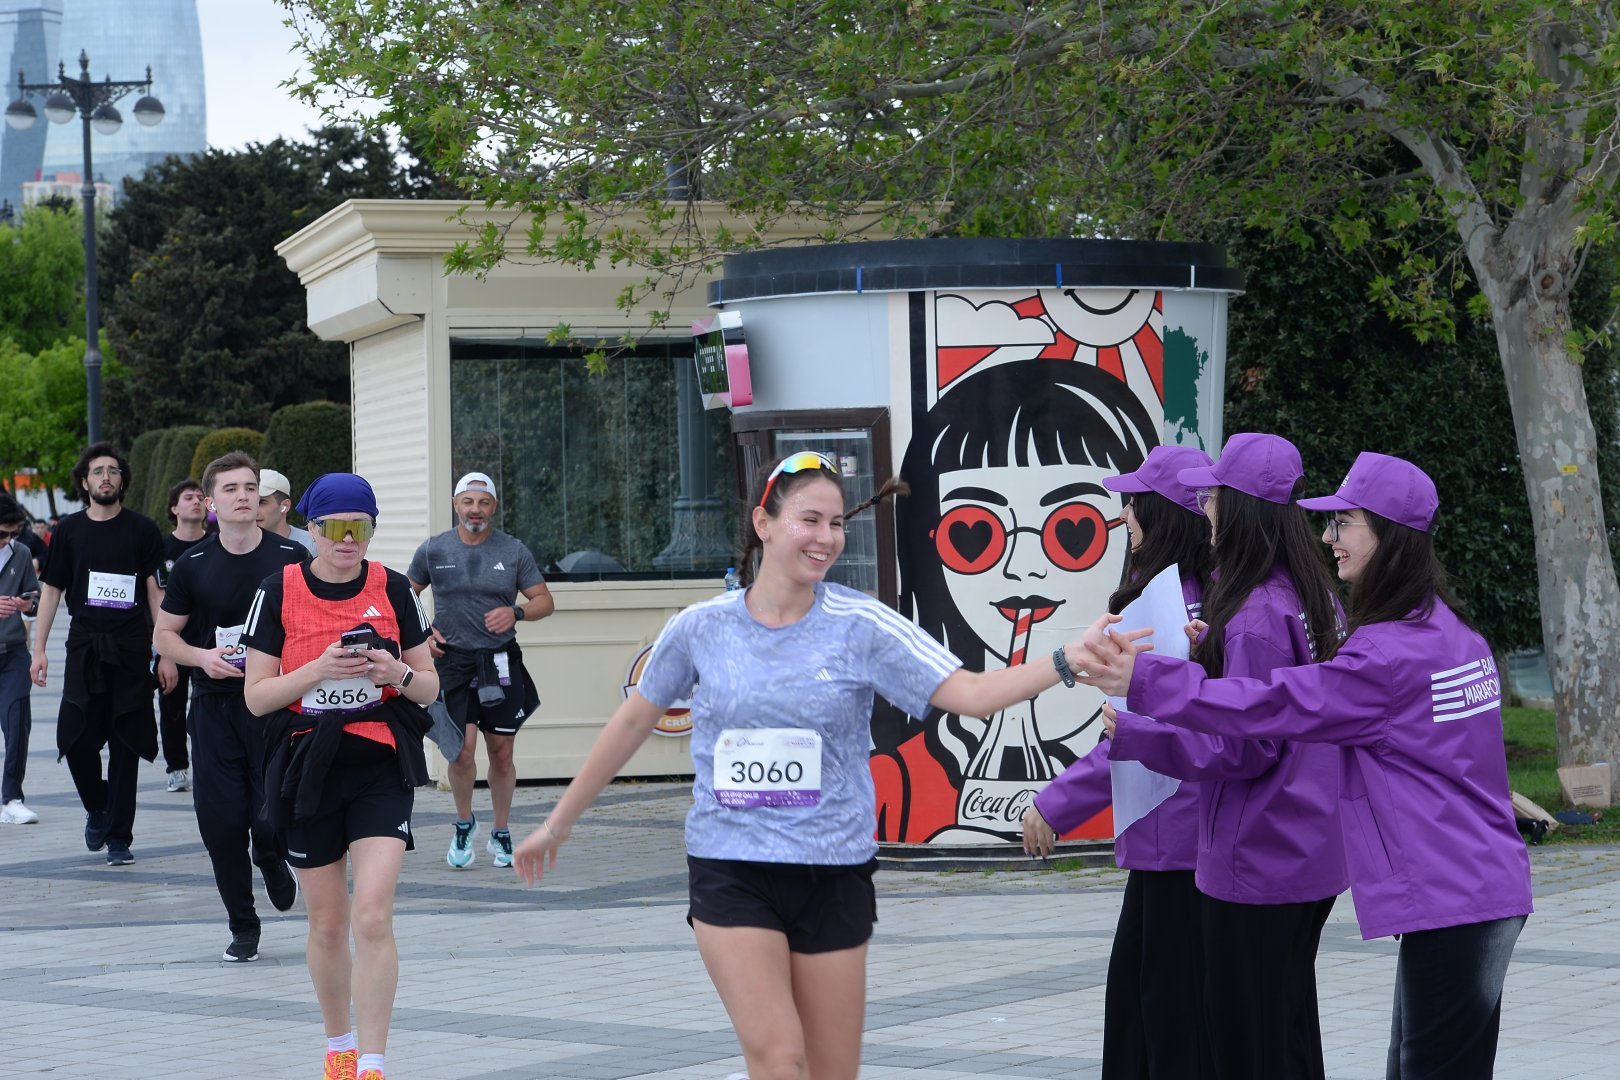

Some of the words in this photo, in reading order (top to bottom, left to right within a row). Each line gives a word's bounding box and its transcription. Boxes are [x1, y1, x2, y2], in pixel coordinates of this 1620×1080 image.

[96, 586, 127, 599] 7656
[315, 687, 368, 705] 3656
[730, 761, 803, 783] 3060
[961, 787, 1039, 823] Coca-Co
